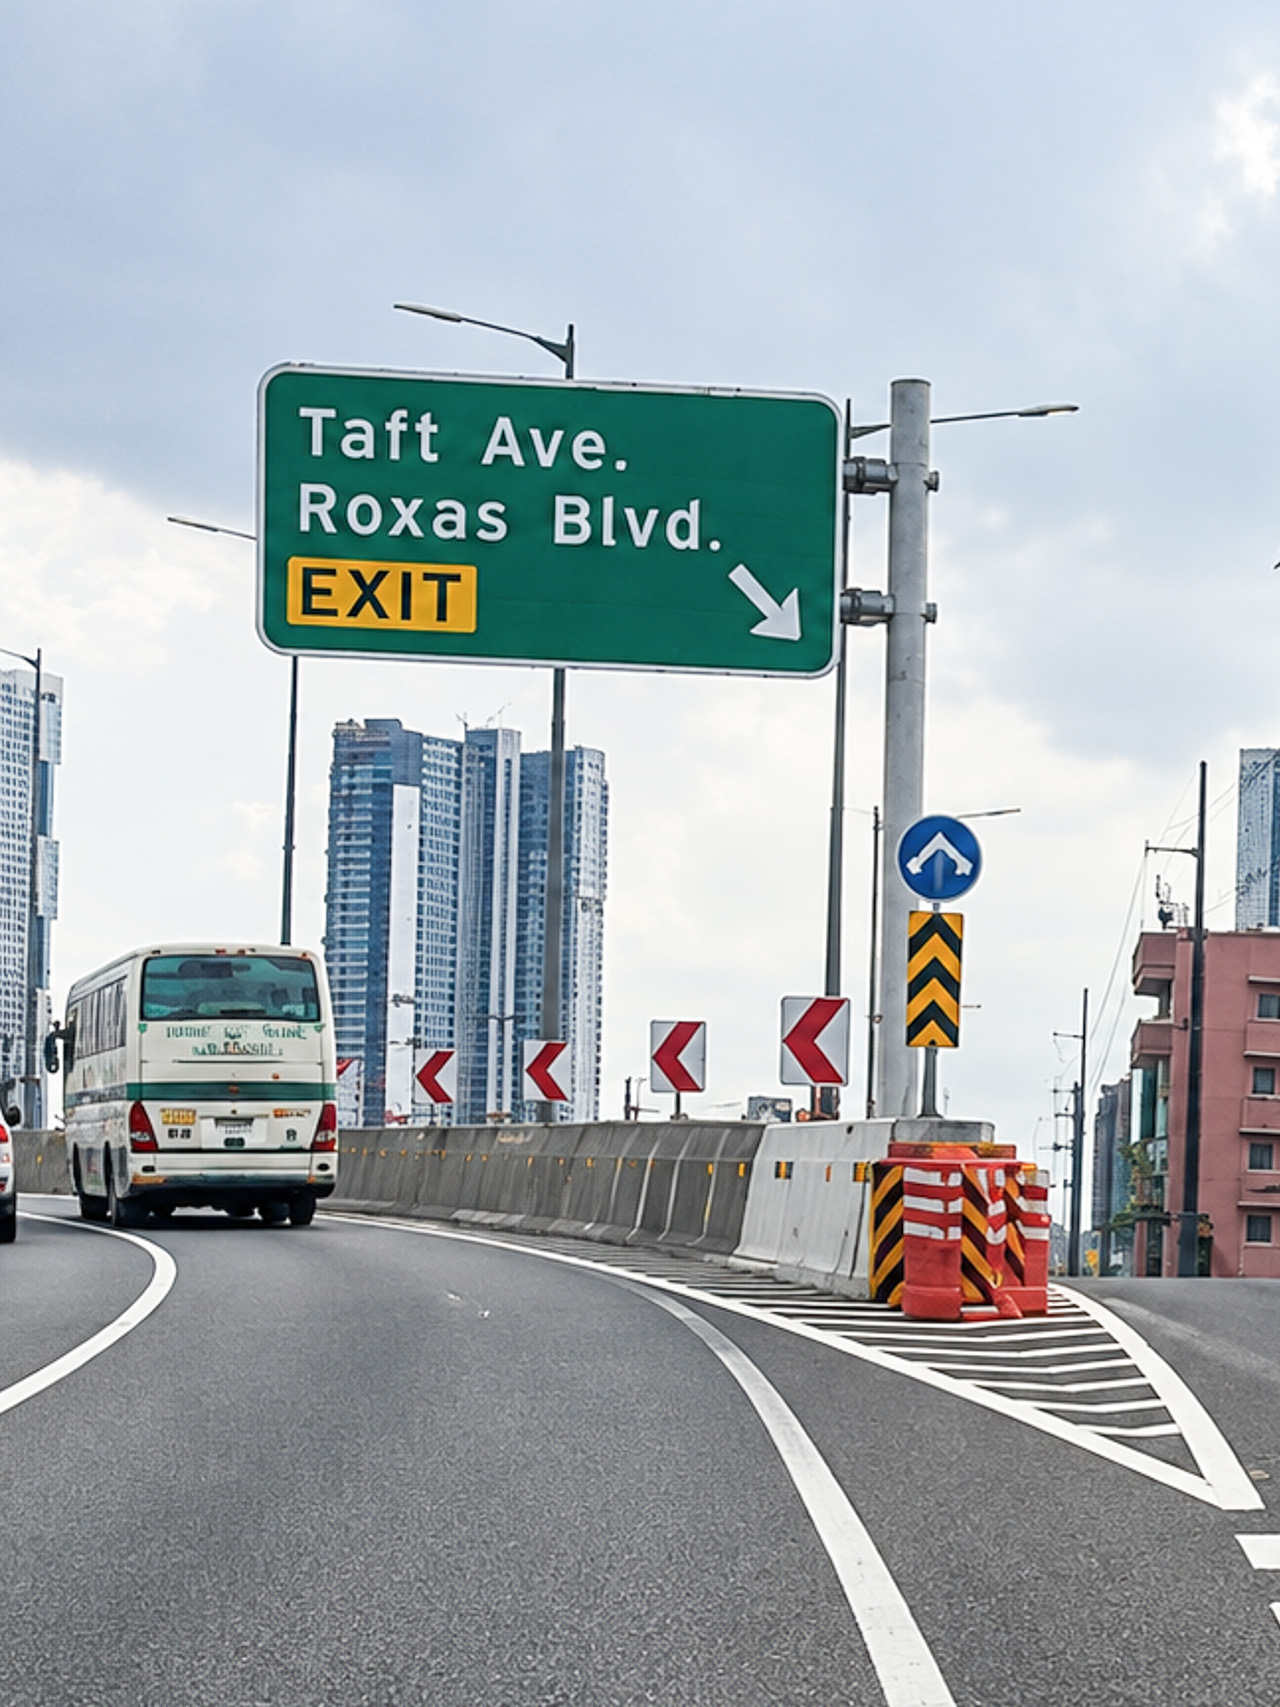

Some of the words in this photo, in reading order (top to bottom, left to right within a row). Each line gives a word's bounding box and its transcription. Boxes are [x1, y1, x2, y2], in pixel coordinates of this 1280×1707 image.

[299, 407, 439, 463] Taft
[481, 416, 628, 471] Ave.
[299, 483, 508, 540] Roxas
[553, 495, 721, 551] Blvd.
[301, 566, 462, 623] EXIT
